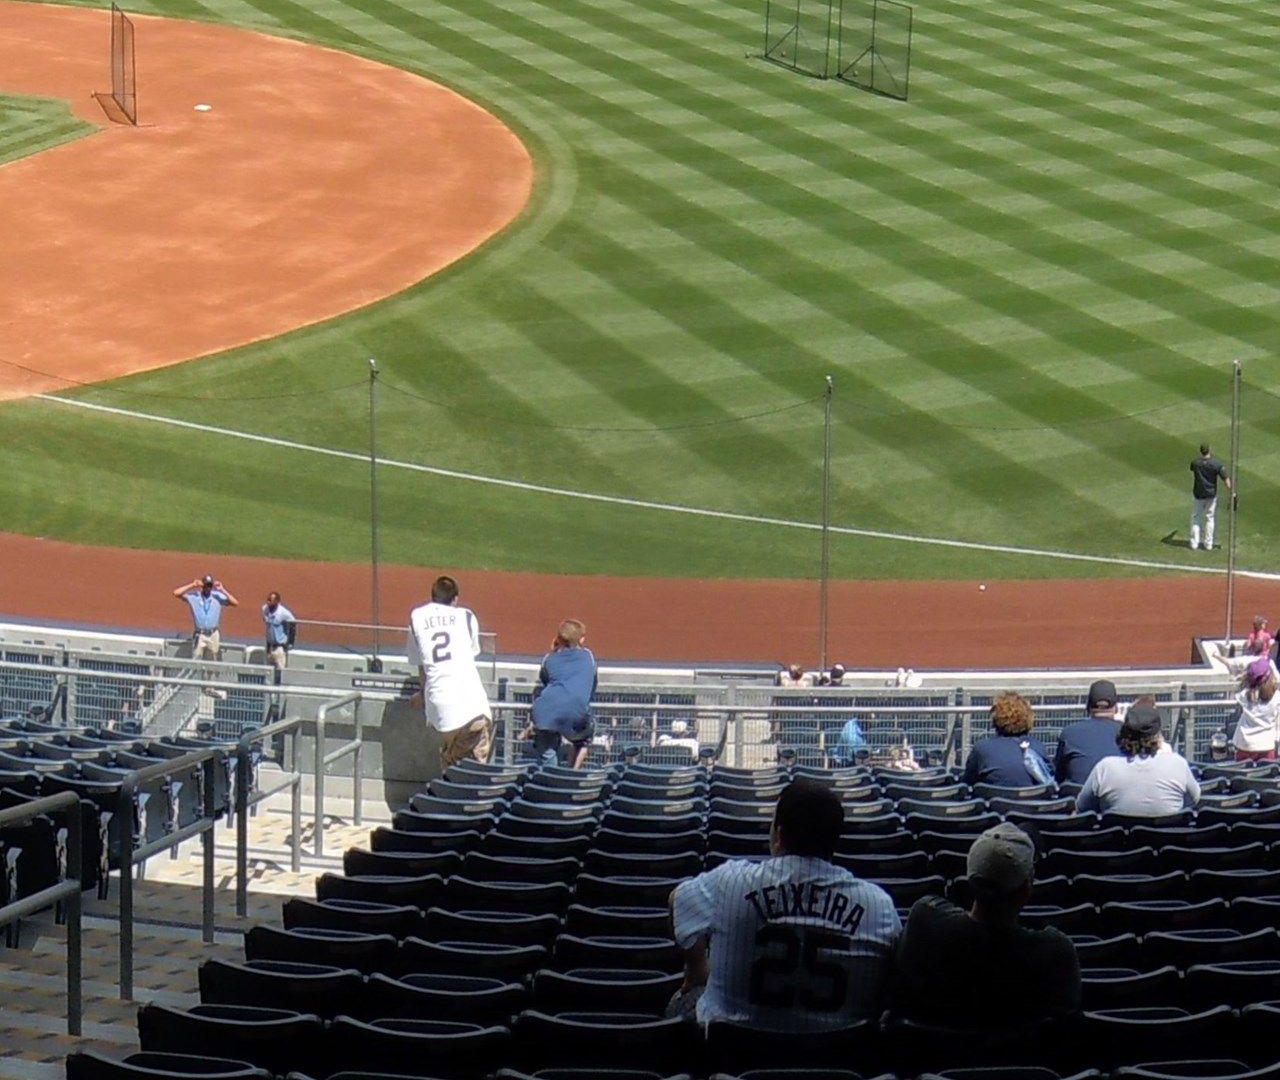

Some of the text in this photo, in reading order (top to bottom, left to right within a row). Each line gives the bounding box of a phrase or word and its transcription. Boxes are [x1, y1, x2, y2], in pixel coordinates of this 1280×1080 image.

[431, 631, 451, 664] 2
[745, 882, 867, 936] TEIXEIRA
[749, 924, 848, 1012] 25
